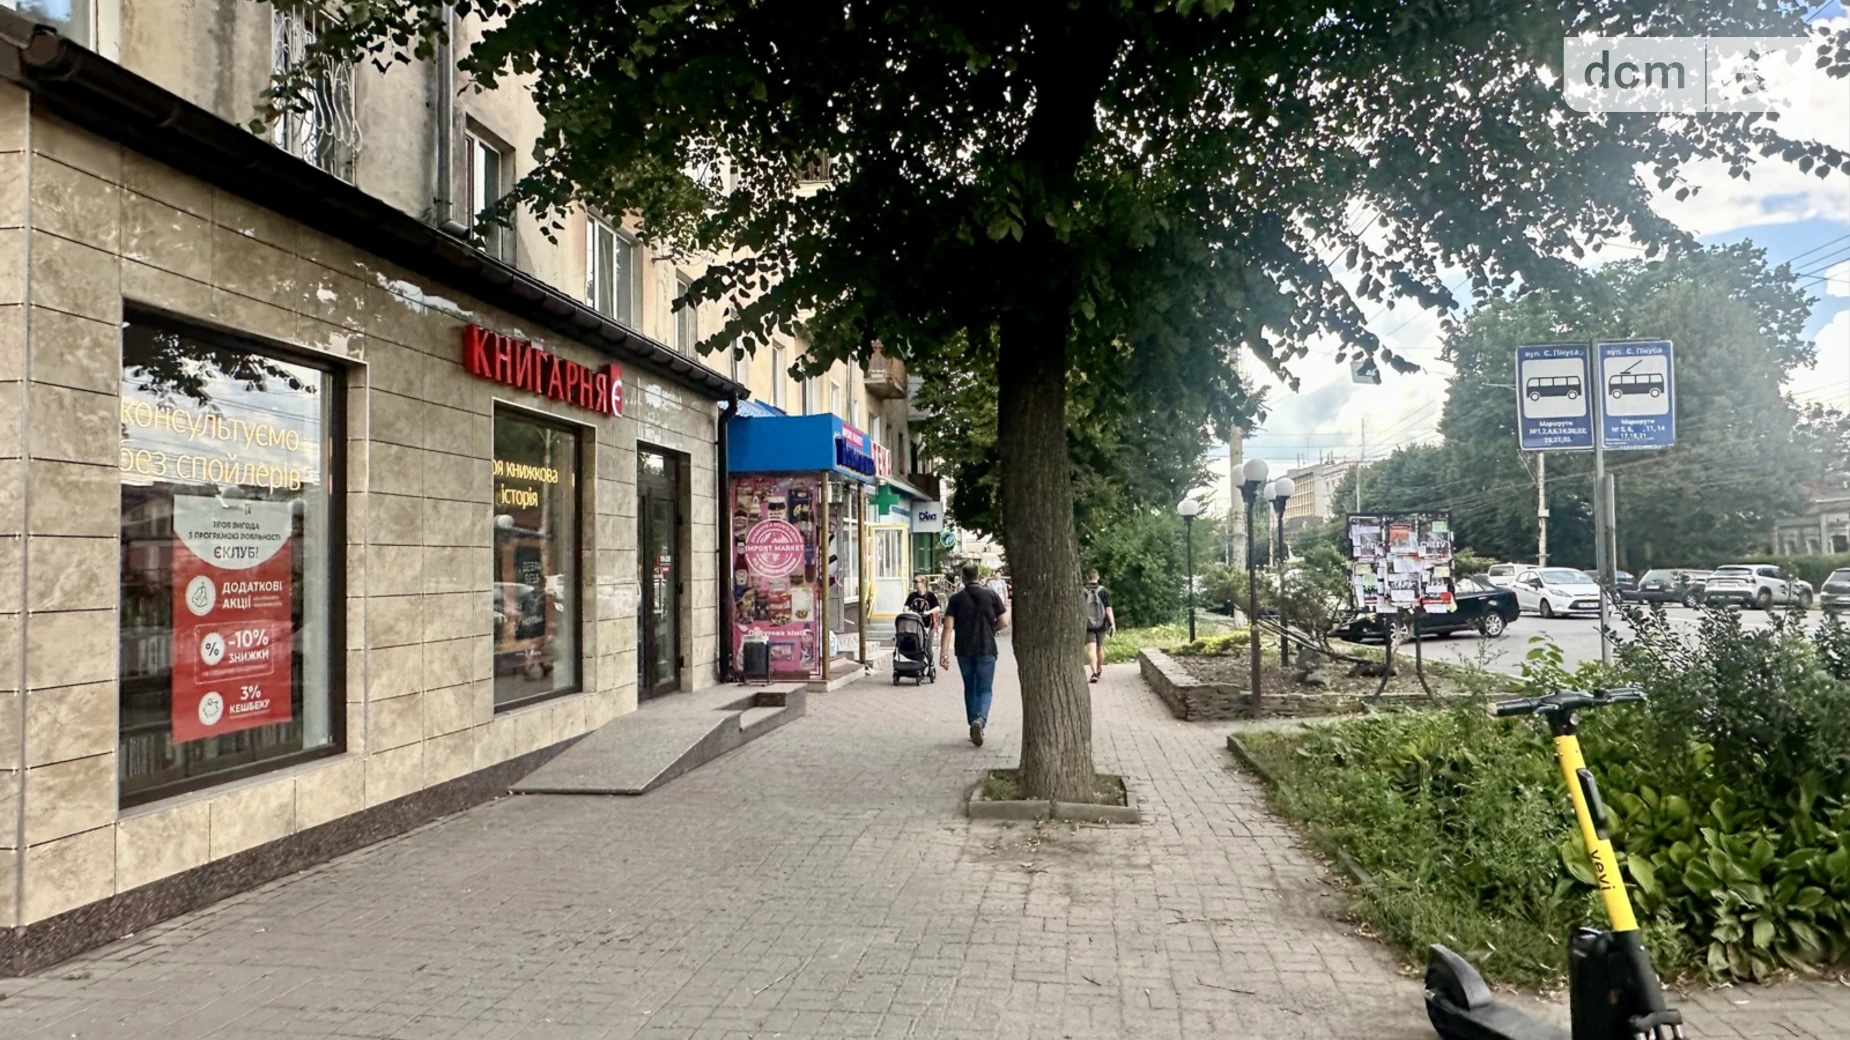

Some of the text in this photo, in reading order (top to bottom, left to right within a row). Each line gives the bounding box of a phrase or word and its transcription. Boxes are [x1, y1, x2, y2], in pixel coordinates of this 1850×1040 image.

[472, 325, 609, 413] КНИГАРНЯ
[121, 397, 300, 452] консультуємо
[177, 452, 301, 494] спойлерів
[506, 461, 559, 484] книжкова
[501, 483, 539, 509] історія
[213, 545, 259, 559] ЄКЛУБ!
[746, 544, 804, 552] IMPORT MARKET
[221, 581, 283, 595] ДОДАТКОВІ
[222, 596, 251, 610] АКЦІЇ
[228, 629, 269, 649] -10%
[228, 649, 269, 664] ЗНИЖКИ
[240, 684, 261, 701] 3%
[229, 699, 270, 714] КЕШБЕКУ
[1591, 850, 1616, 890] vevi
